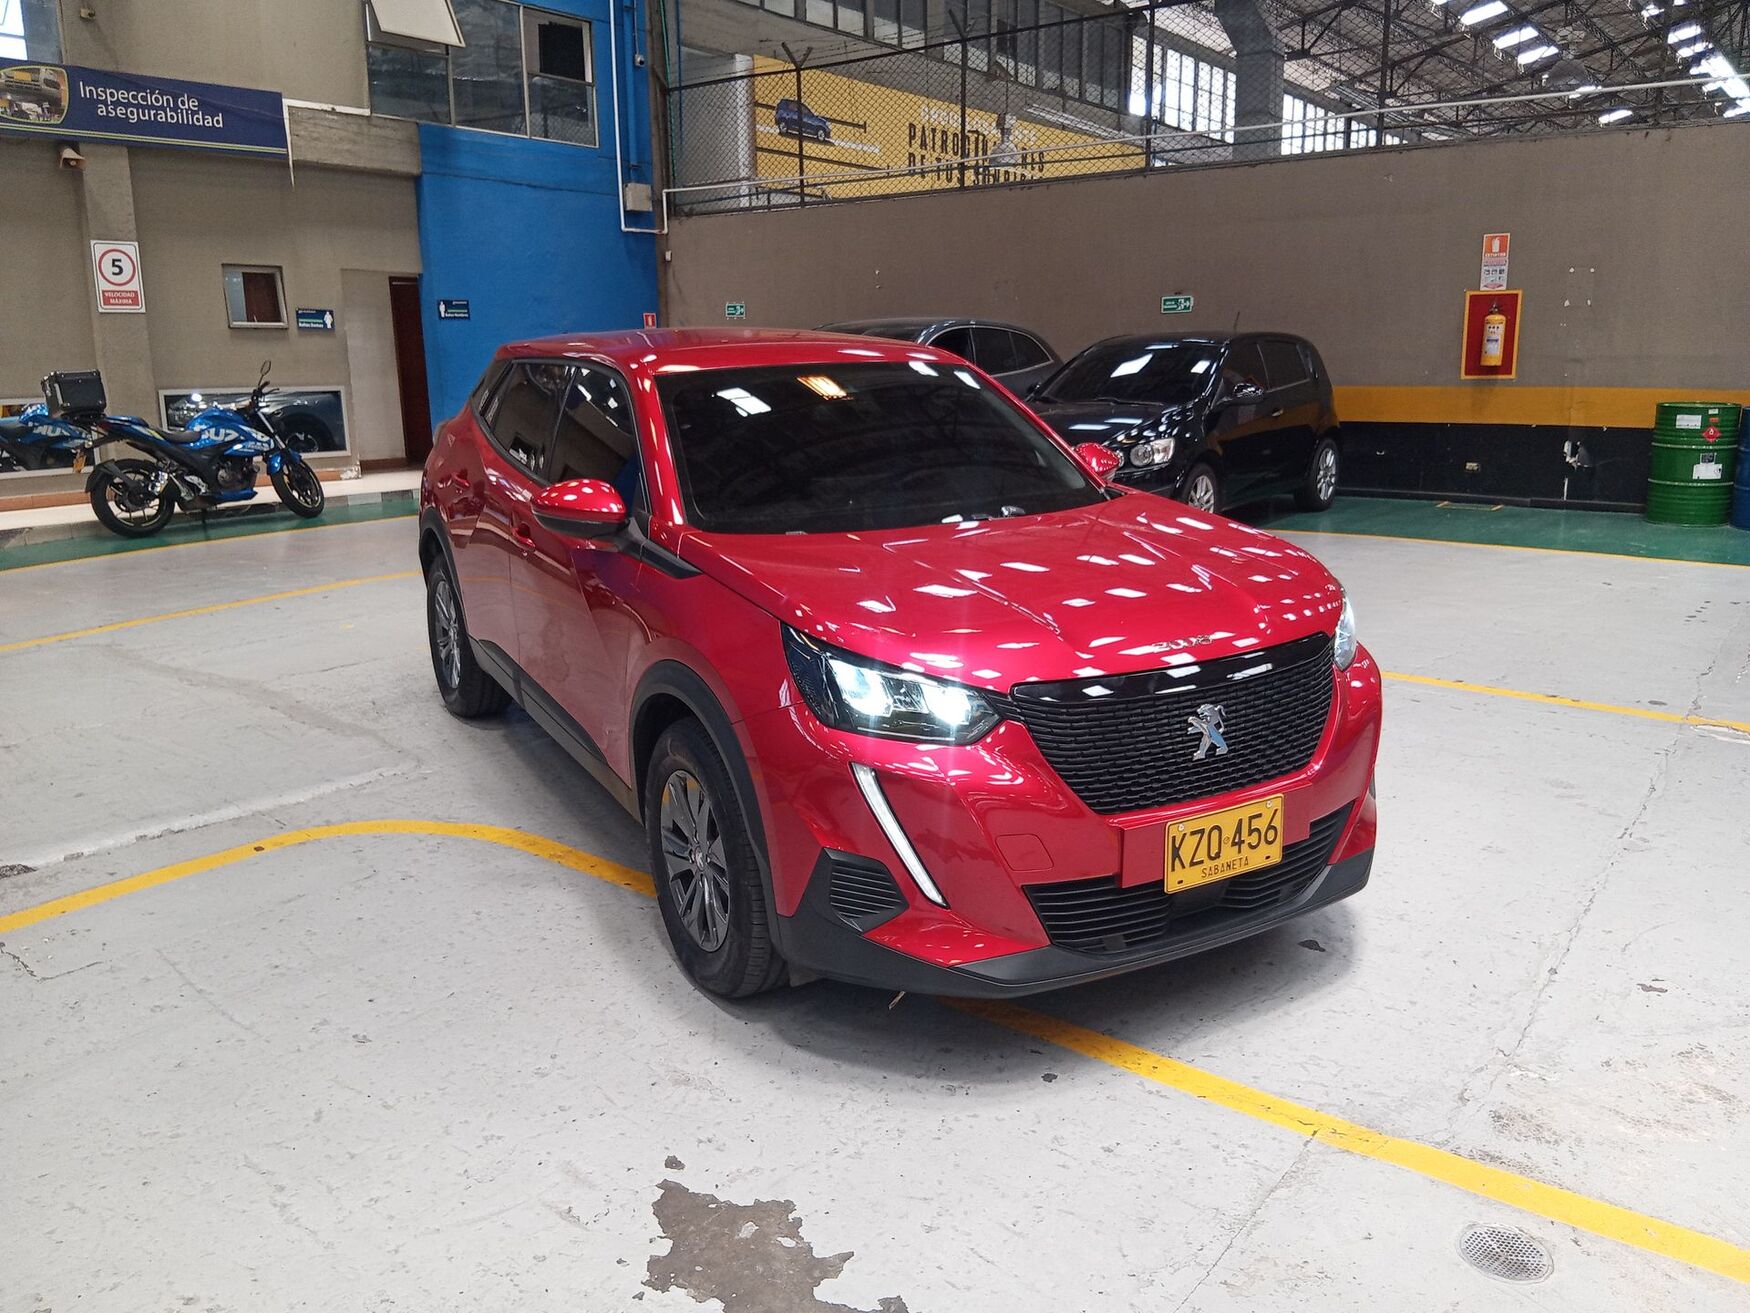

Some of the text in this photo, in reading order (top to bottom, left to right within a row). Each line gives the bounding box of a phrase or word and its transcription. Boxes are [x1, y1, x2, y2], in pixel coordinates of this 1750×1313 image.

[79, 81, 199, 110] Inspección de
[97, 104, 224, 128] asegurabilidad
[111, 258, 124, 276] 5
[1231, 808, 1279, 854] 456
[1201, 855, 1249, 879] SABANETA
